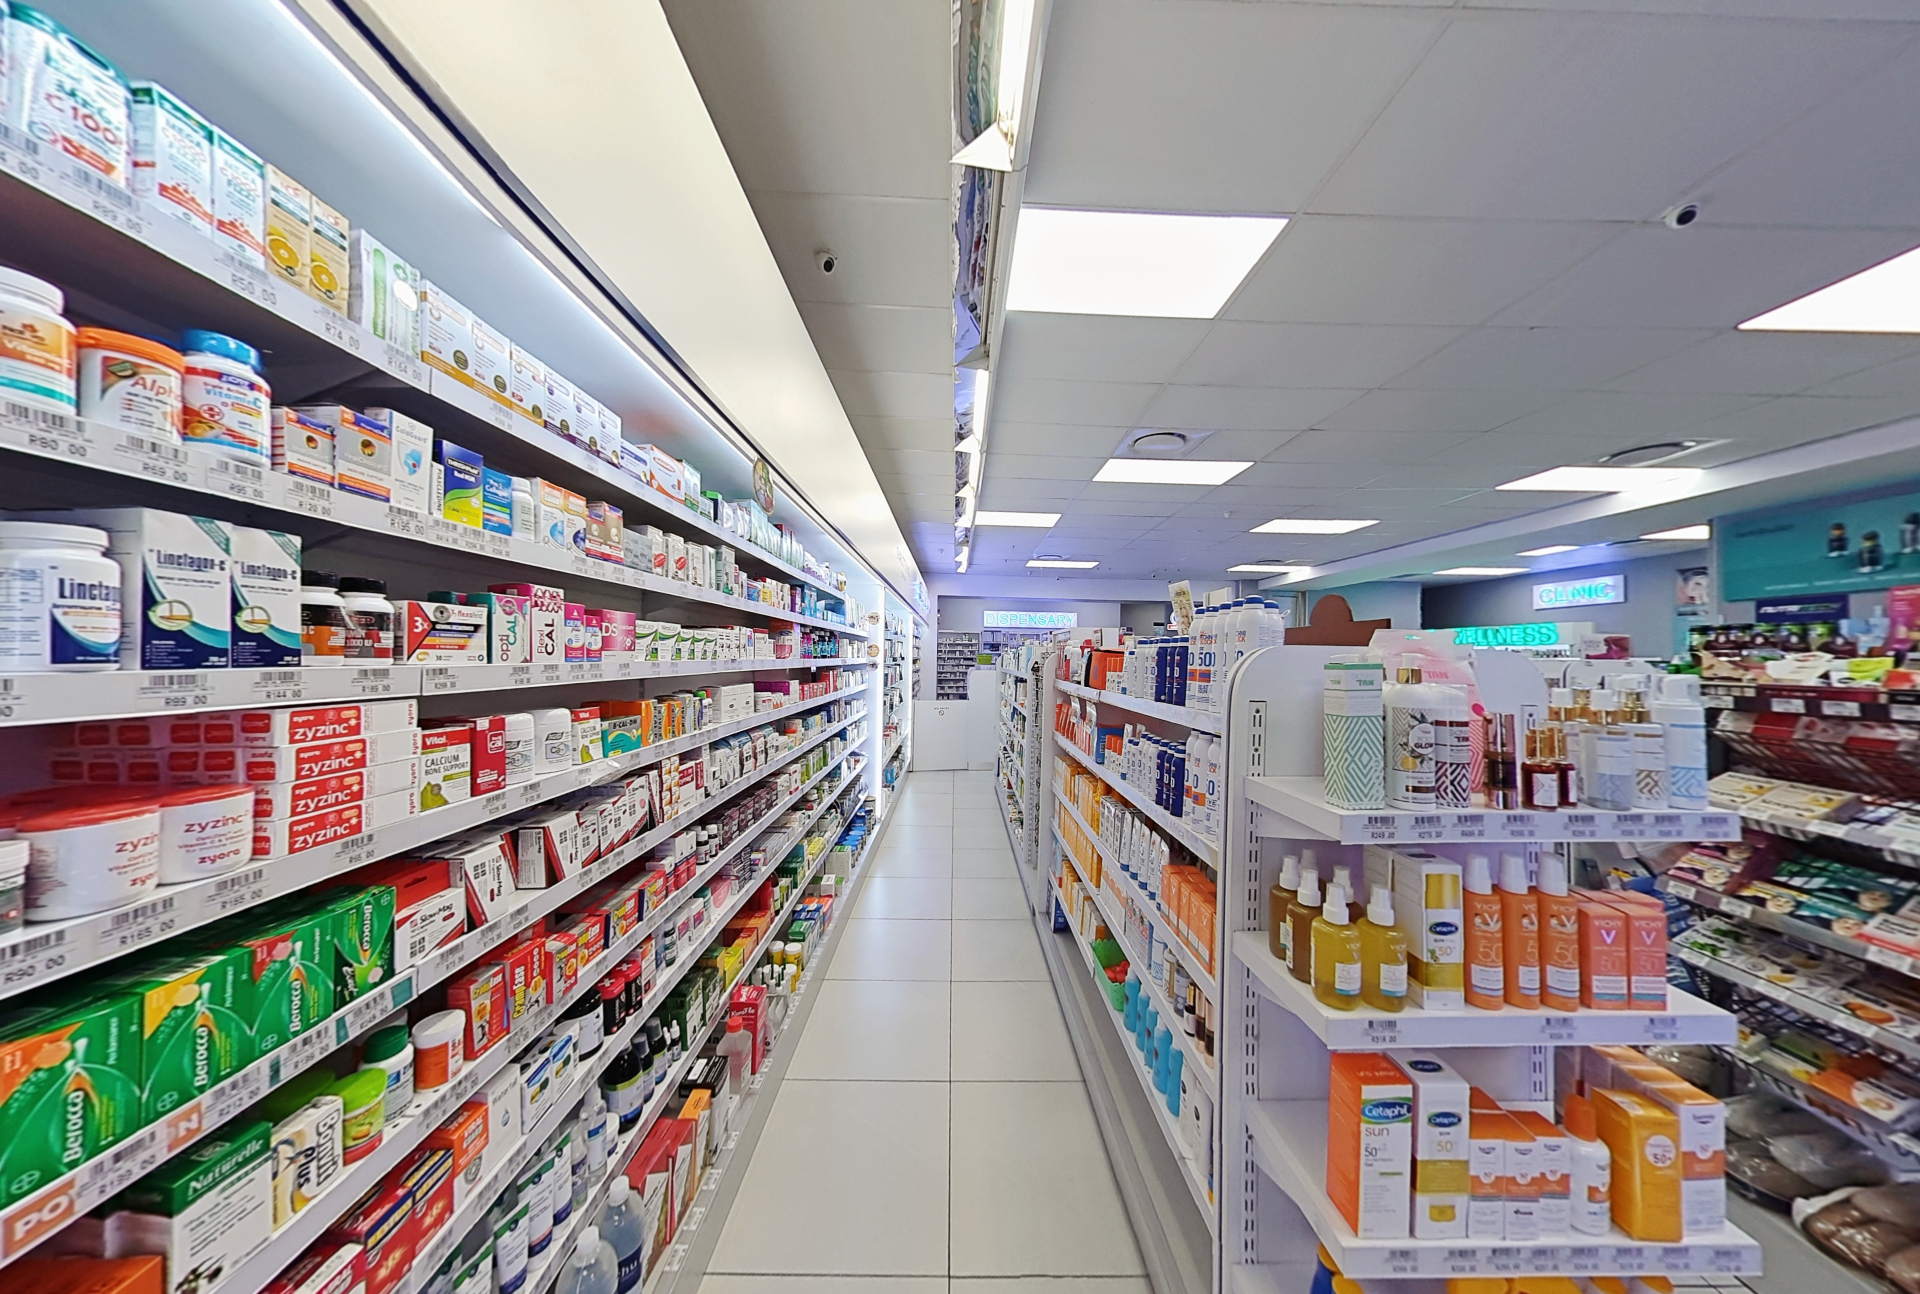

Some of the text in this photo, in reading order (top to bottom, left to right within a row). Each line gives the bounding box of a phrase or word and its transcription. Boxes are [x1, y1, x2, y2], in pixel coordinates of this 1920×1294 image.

[230, 273, 278, 305] R50.00
[325, 322, 360, 351] R74.00
[390, 518, 425, 536] R195.00
[1539, 581, 1614, 605] CLINIC
[985, 612, 1076, 626] DISPENSARY
[1356, 679, 1375, 687] TAN
[1423, 670, 1450, 680] TAN
[294, 722, 349, 740] zyzinc
[425, 735, 447, 746] Vital
[301, 755, 354, 776] zyzinc
[424, 755, 460, 769] CALCIUM
[424, 761, 469, 777] BONE SUPPORT
[296, 790, 352, 812] zyzinc
[183, 813, 244, 834] zyzinc
[294, 823, 350, 848] zyzinc
[198, 848, 241, 865] zyoro
[419, 902, 454, 924] SlowMag
[363, 904, 373, 950] Berocca
[1430, 924, 1458, 934] Cetaphil
[1593, 919, 1622, 928] VICHY
[1633, 920, 1663, 928] VICHY
[4, 954, 66, 985] R90.00
[290, 980, 301, 1034] Berocca
[194, 1026, 209, 1087] Berocca
[1363, 1103, 1412, 1121] Cetaphil
[1429, 1115, 1461, 1126] Cetaphil
[63, 1090, 84, 1163] Berocca
[1364, 1126, 1390, 1138] sun
[316, 1109, 340, 1188] Bonvit
[187, 1137, 265, 1200] Naturelle
